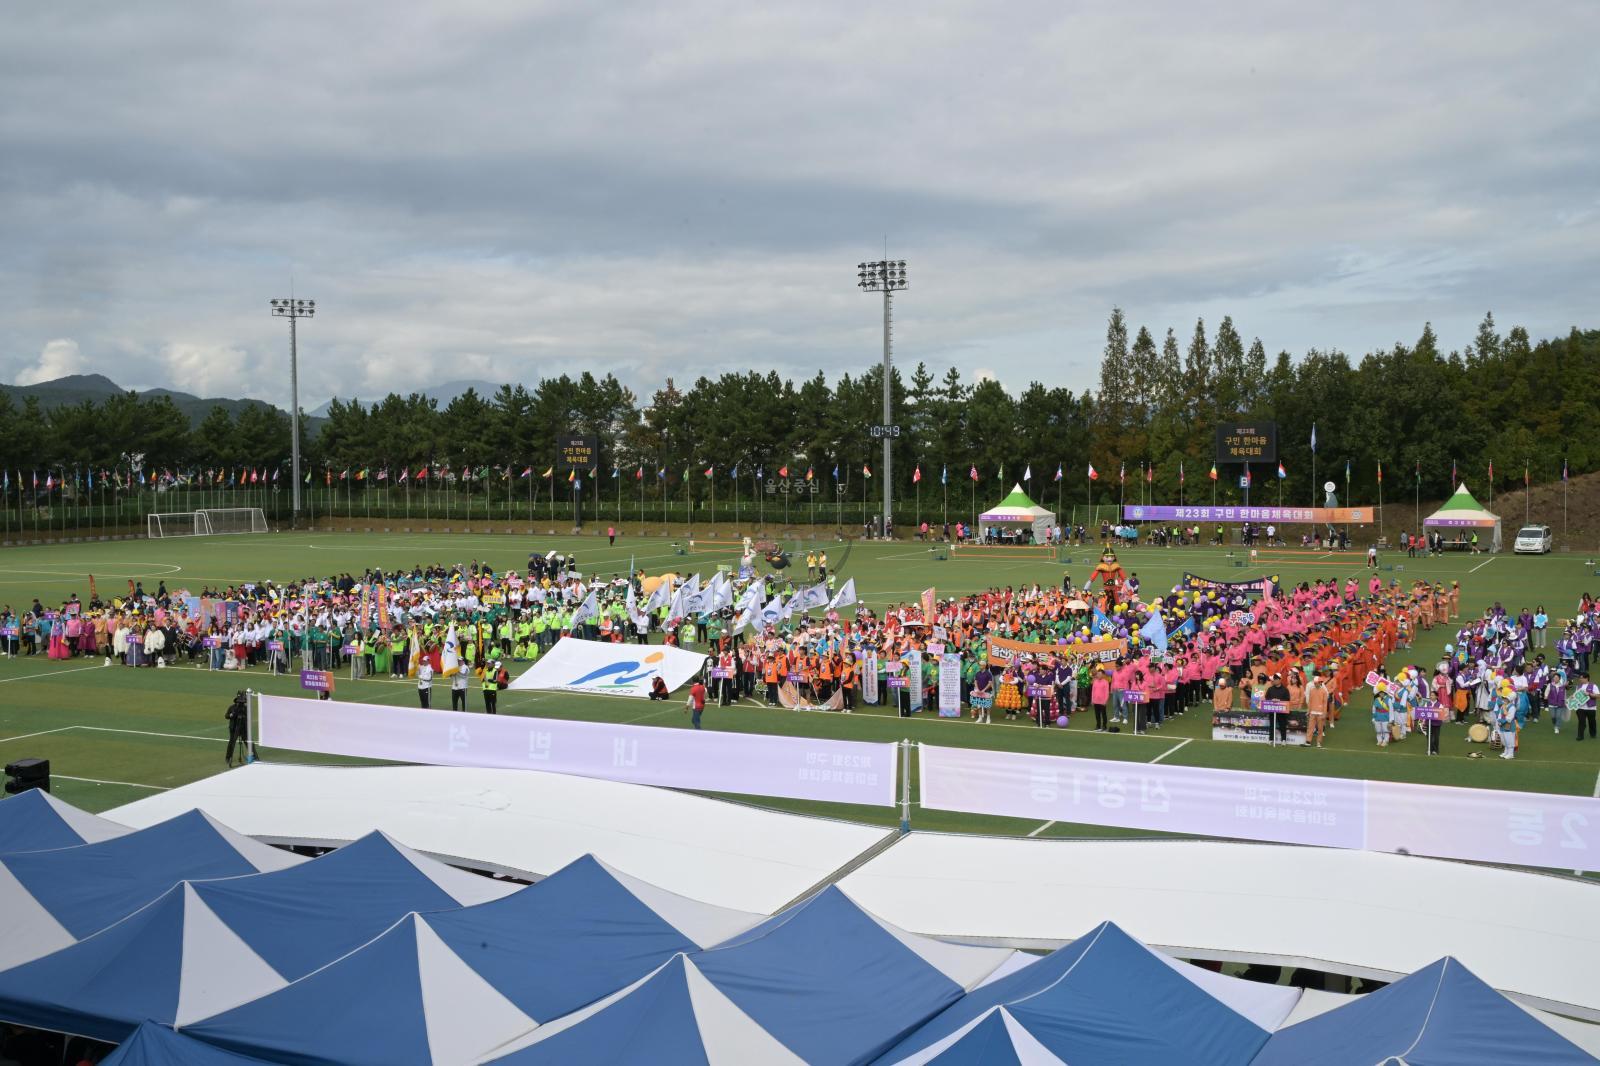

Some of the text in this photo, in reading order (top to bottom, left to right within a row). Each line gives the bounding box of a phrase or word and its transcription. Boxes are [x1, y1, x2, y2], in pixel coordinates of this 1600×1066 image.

[870, 425, 900, 437] 10:49
[1225, 436, 1267, 446] 구민 한마음
[1230, 447, 1262, 456] 체육대회
[1241, 476, 1248, 487] B
[1175, 507, 1314, 521] 제23회 구민 한마음체육대회
